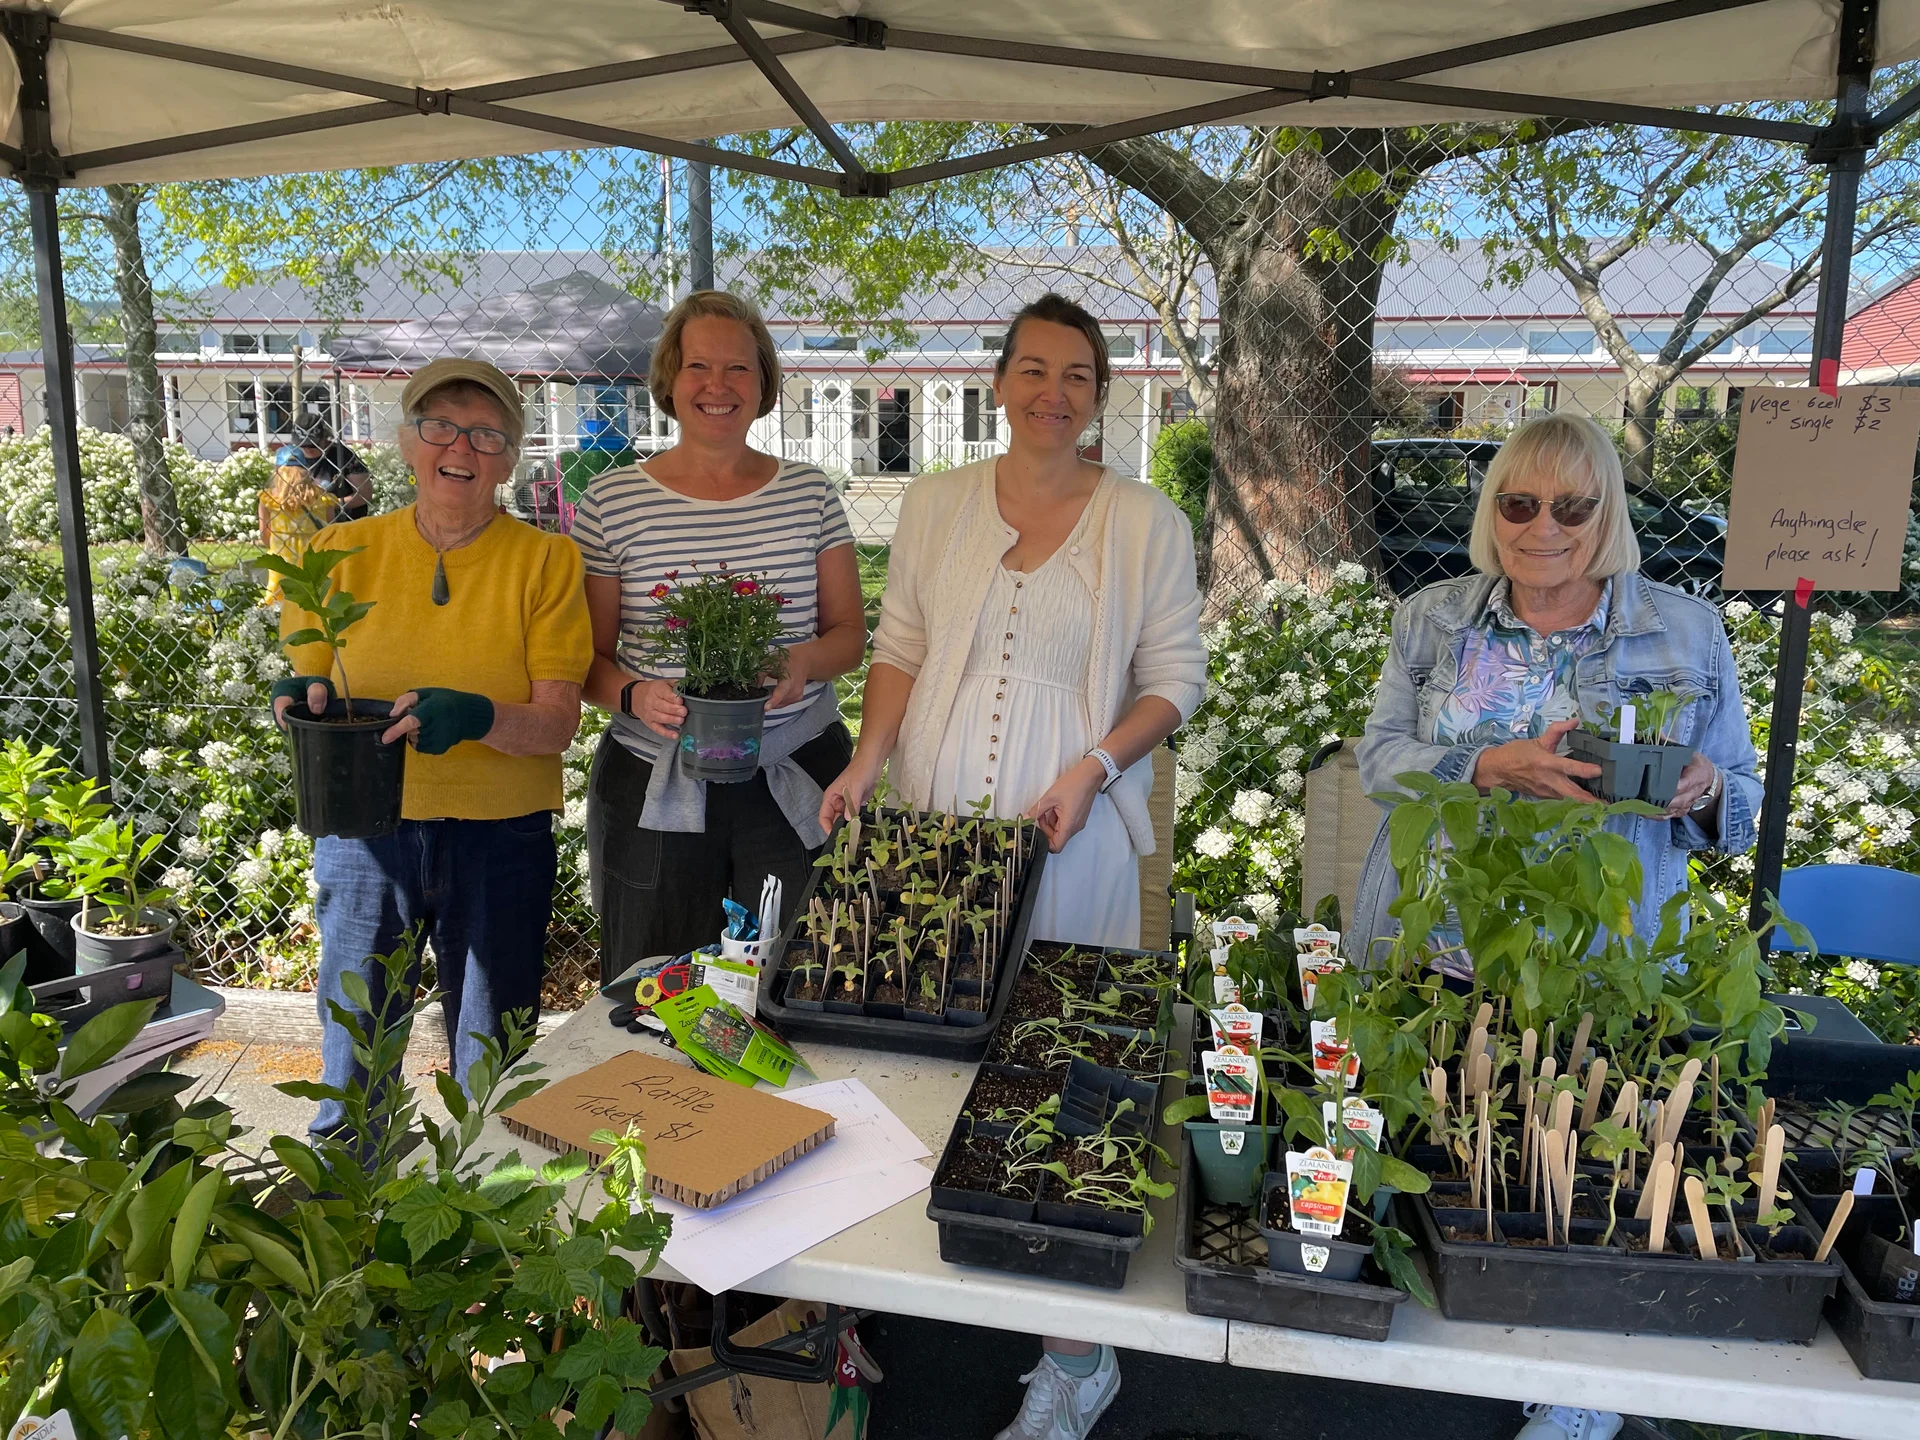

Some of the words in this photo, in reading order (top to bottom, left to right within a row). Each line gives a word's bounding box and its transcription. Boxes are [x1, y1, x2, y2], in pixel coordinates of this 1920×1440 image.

[1750, 395, 1791, 419] Vege
[1859, 395, 1891, 415] $3
[1853, 413, 1881, 434] $2
[1766, 543, 1811, 570] please
[1213, 1056, 1249, 1064] ZEALANDIA
[621, 1075, 715, 1113] Raffle
[1217, 1093, 1247, 1101] courgette
[574, 1095, 647, 1125] Tickets
[1344, 1109, 1375, 1119] ALANDIA
[654, 1121, 703, 1143] $1
[1299, 1160, 1341, 1171] ZEALANDIA
[1300, 1200, 1335, 1212] capsicum
